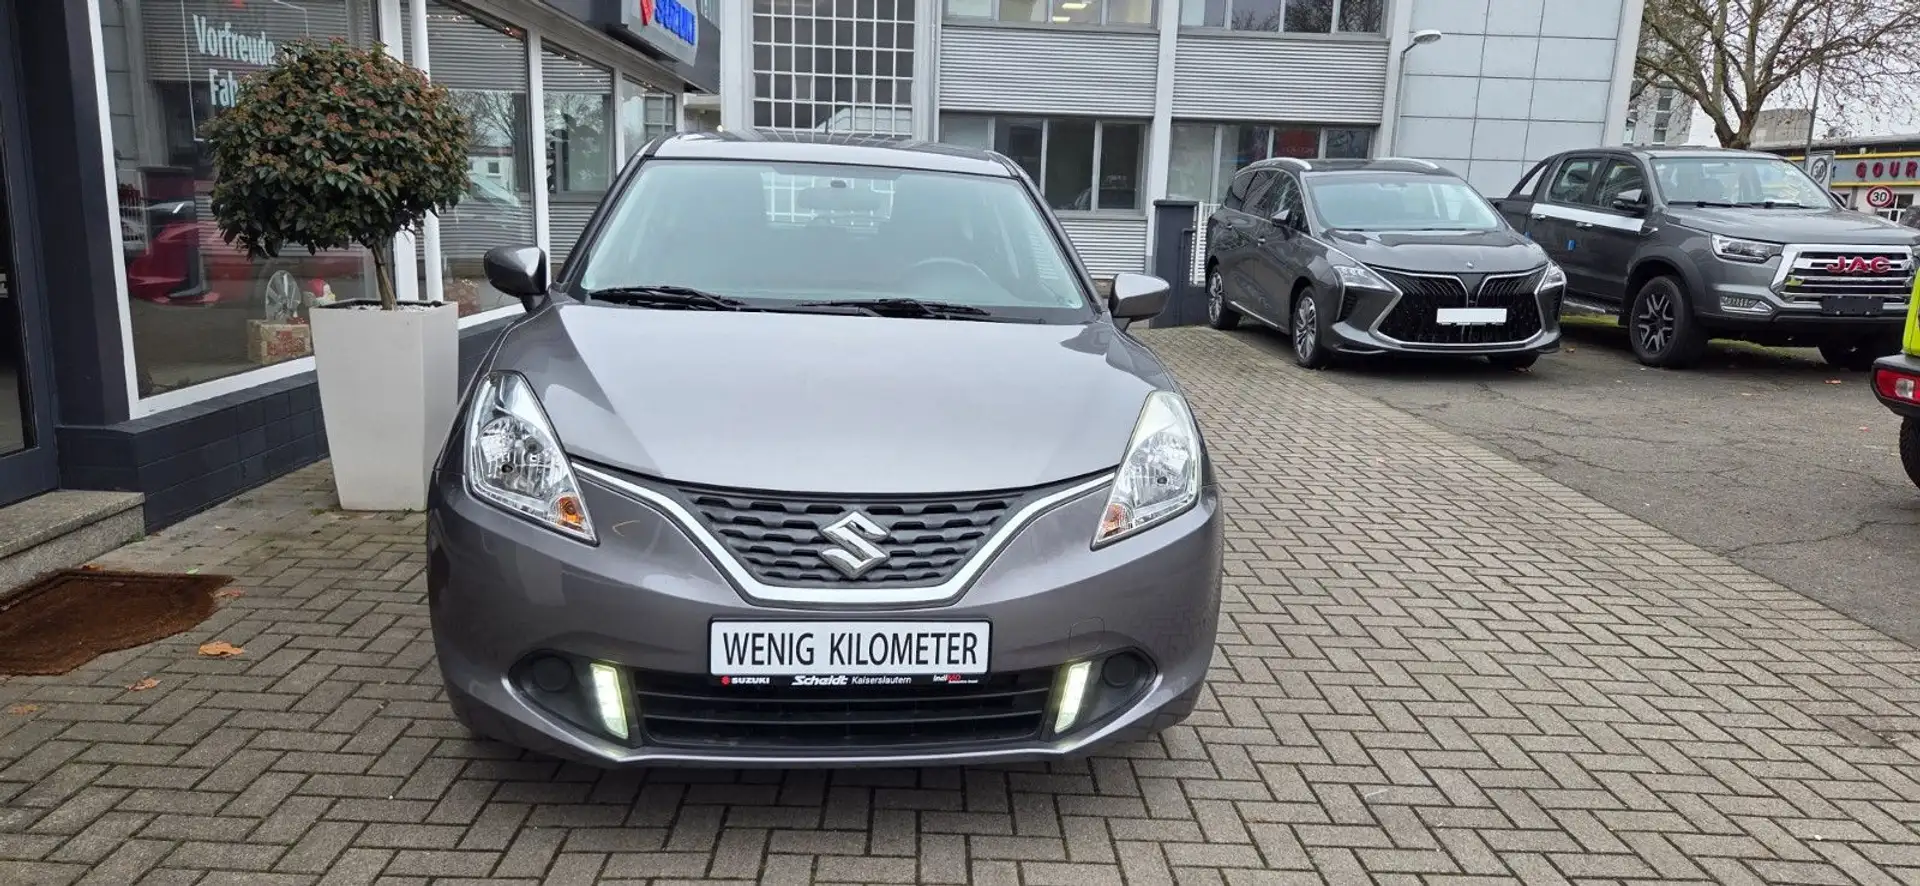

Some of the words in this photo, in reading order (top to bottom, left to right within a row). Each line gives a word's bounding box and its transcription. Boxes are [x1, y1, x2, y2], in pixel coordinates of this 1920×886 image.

[193, 14, 277, 66] Vorfreude
[1872, 191, 1887, 202] 30
[1826, 255, 1892, 274] JAC
[723, 632, 815, 666] WENIG
[829, 632, 978, 666] KILOMETER
[731, 677, 770, 685] SUZUKI
[851, 675, 912, 685] Kaiserslautern
